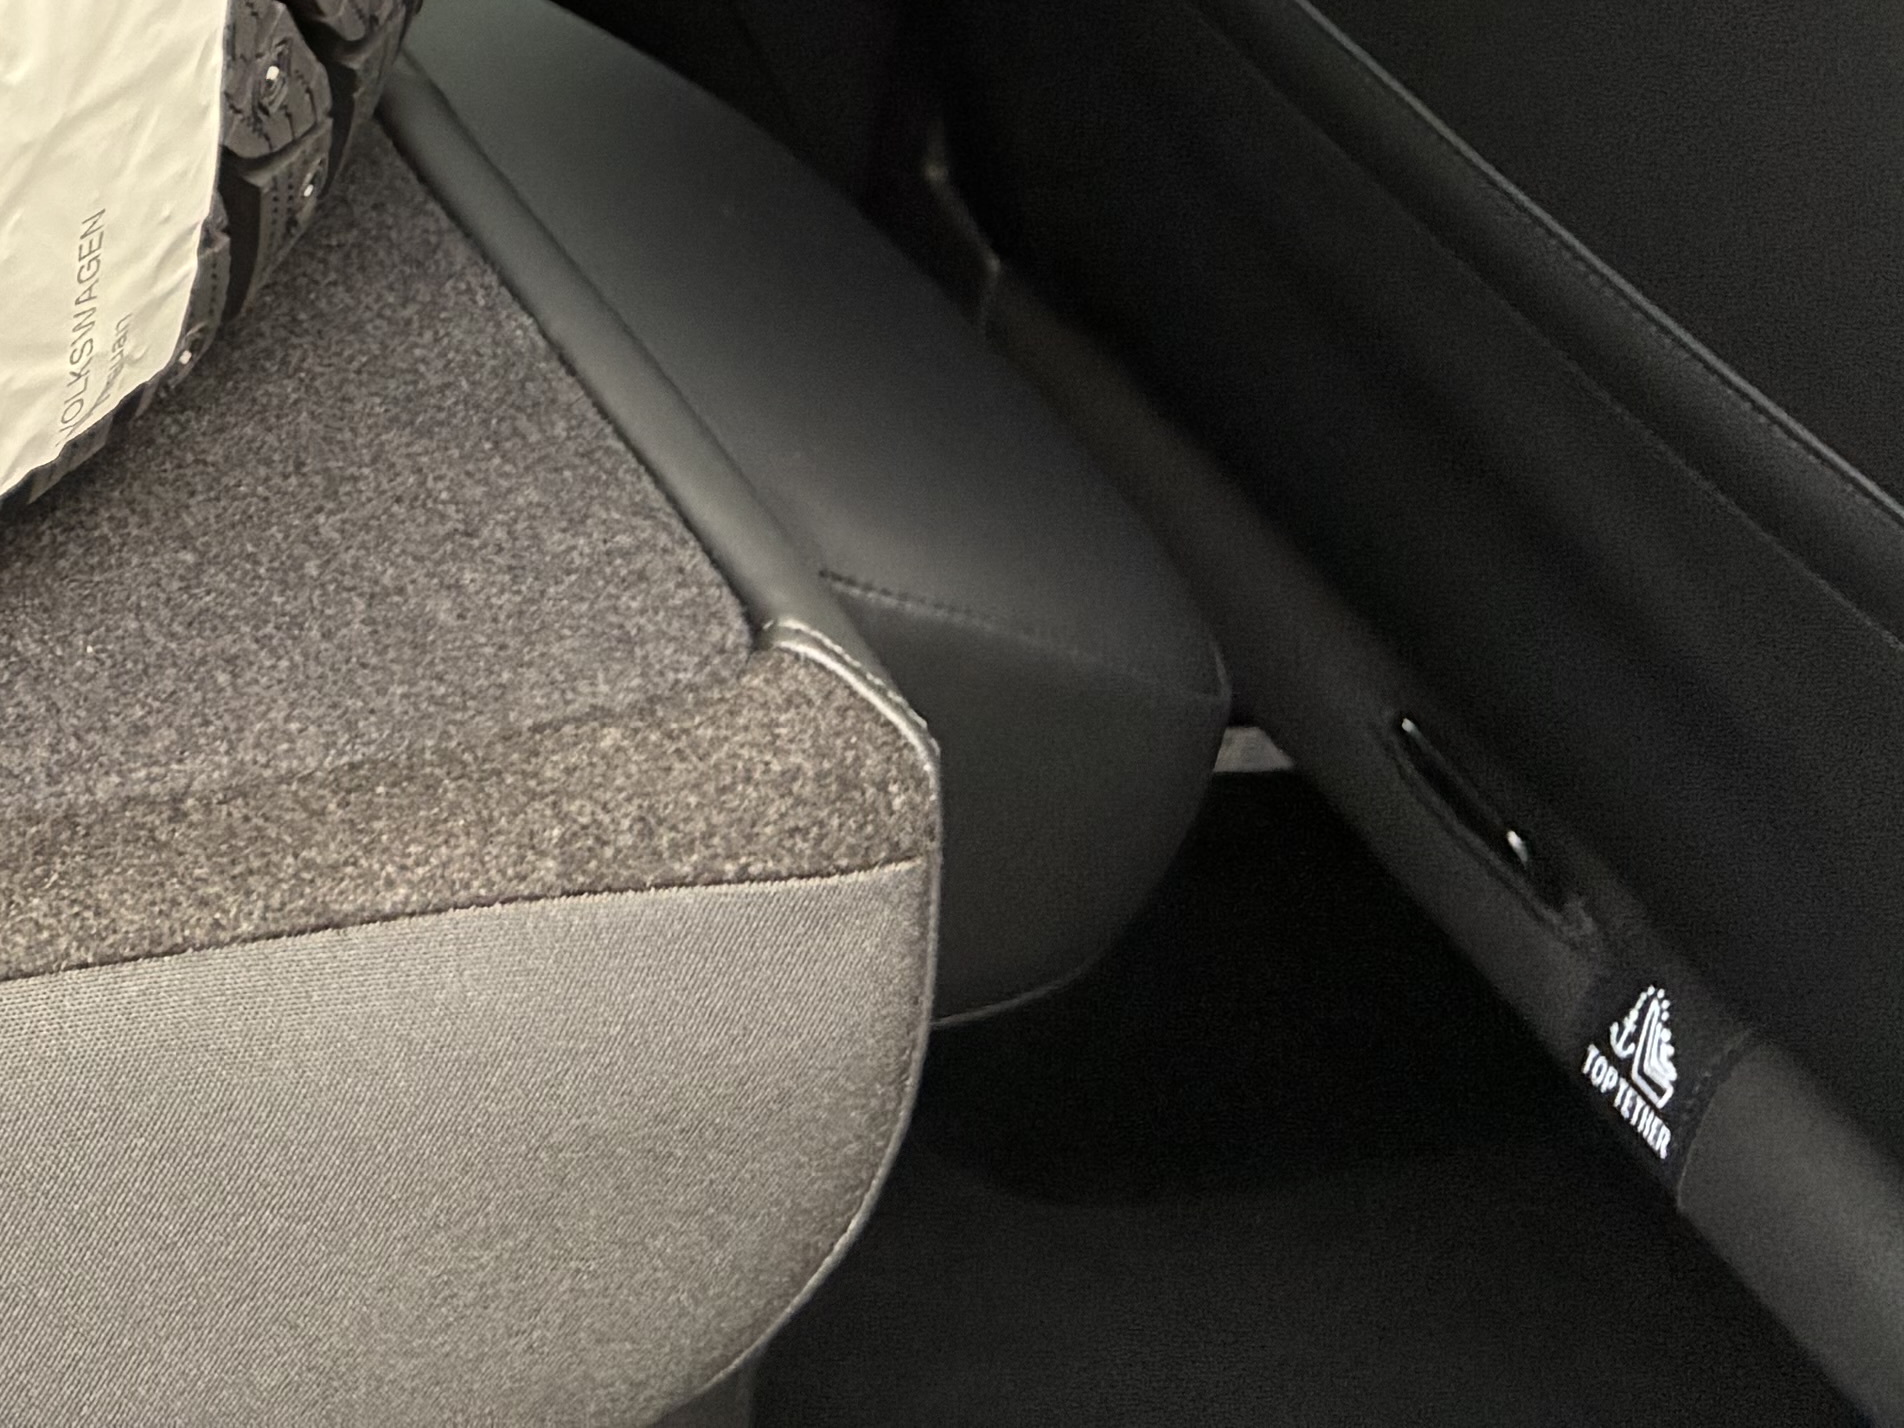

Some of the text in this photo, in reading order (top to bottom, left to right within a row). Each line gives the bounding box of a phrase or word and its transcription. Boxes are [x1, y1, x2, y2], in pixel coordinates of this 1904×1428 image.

[55, 208, 106, 447] VOLKSWAGEN
[1582, 1043, 1672, 1160] TOP TETHER
